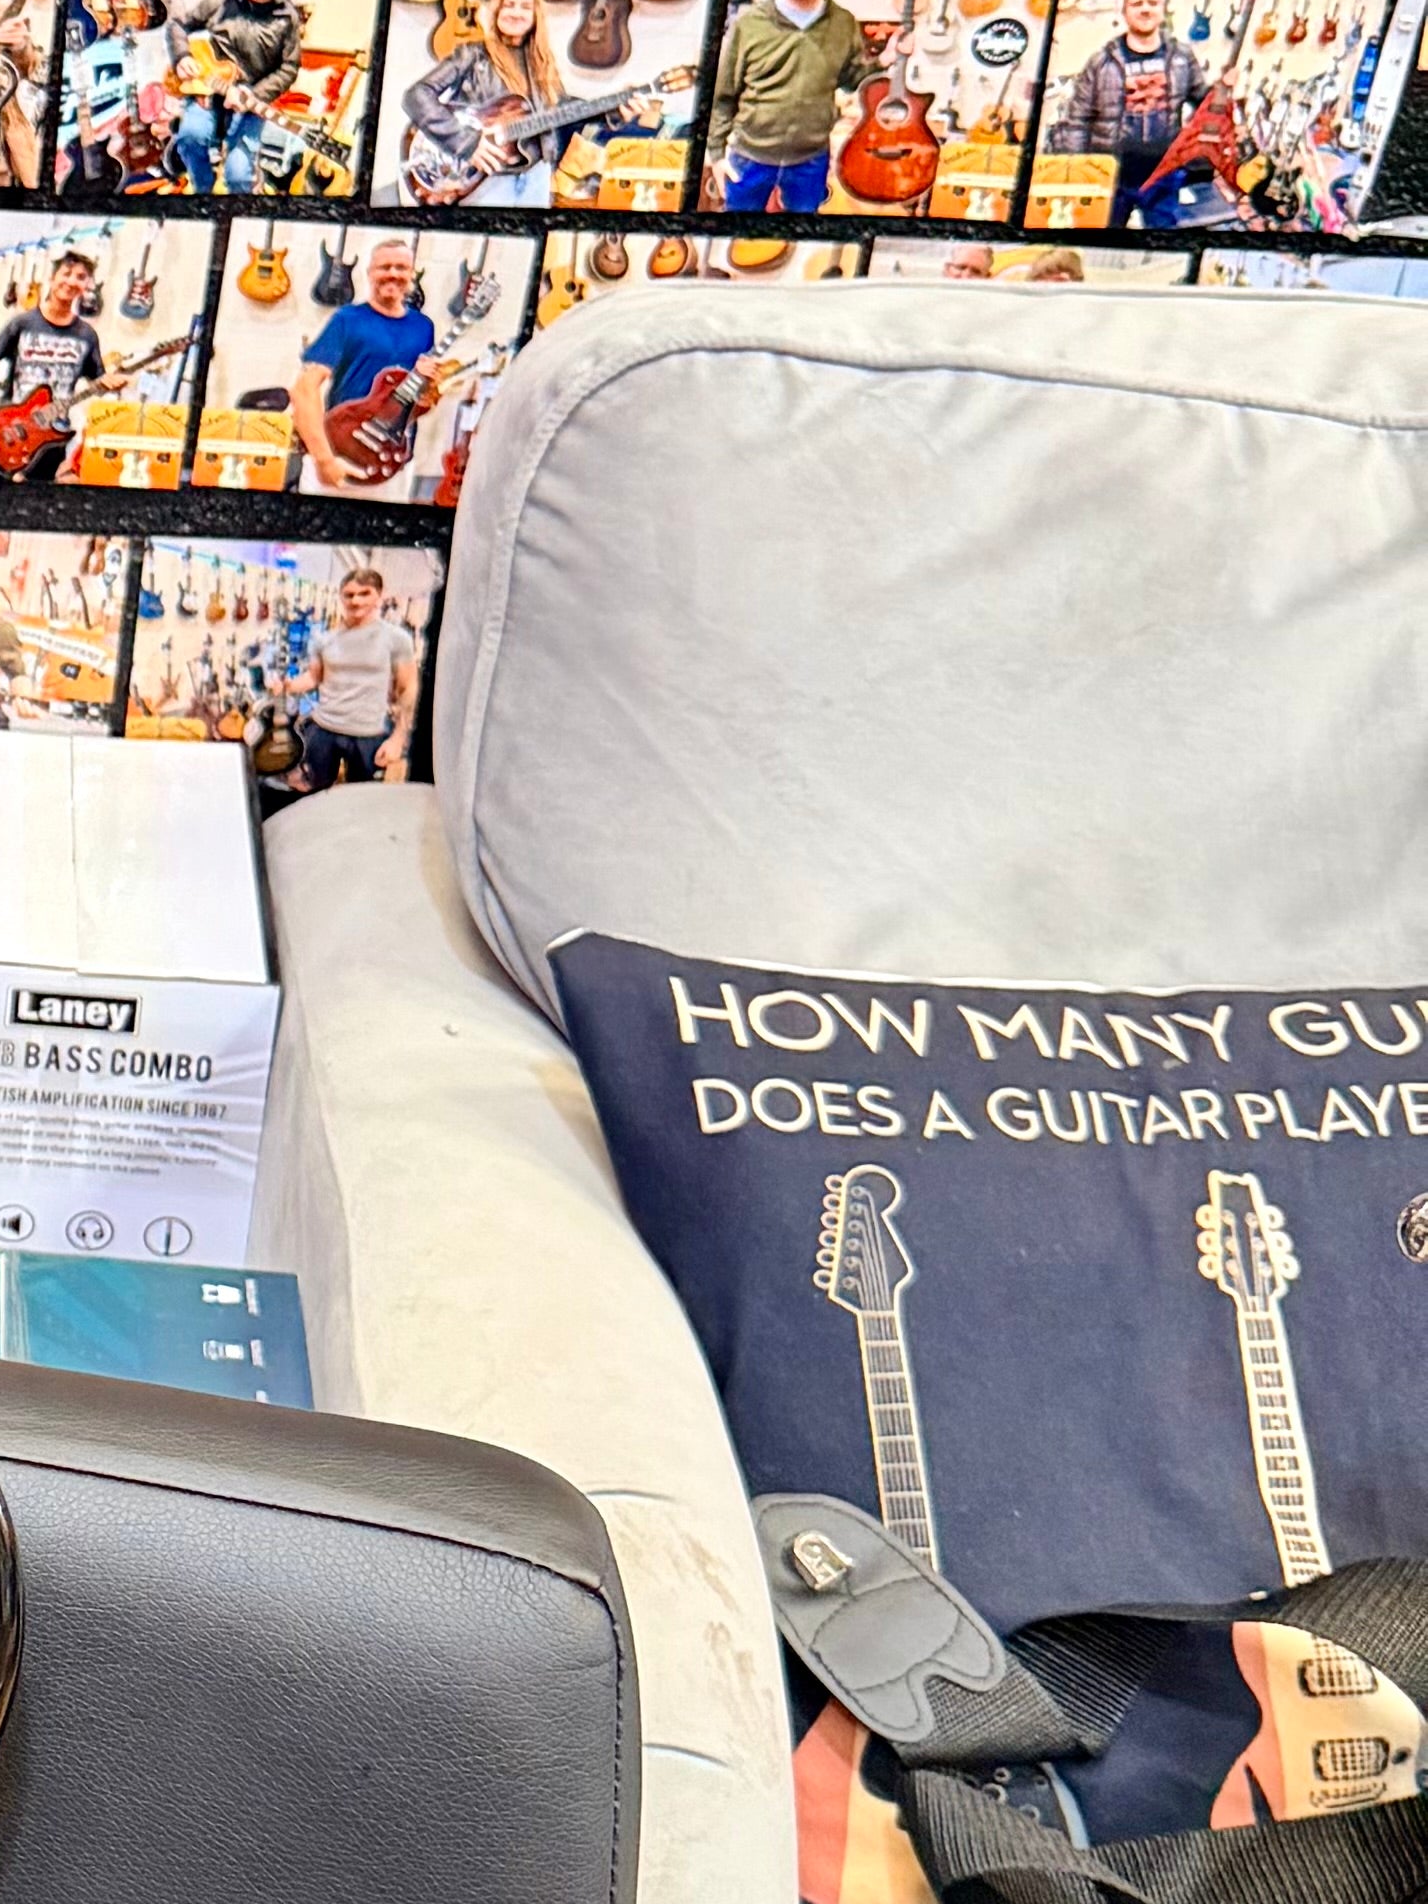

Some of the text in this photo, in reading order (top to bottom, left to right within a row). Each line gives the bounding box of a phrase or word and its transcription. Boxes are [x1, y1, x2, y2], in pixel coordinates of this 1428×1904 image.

[17, 989, 131, 1032] Laney
[668, 976, 930, 1061] HOW
[956, 1001, 1233, 1072] MANY
[23, 1041, 102, 1075] BASS
[109, 1047, 214, 1083] COMBO
[29, 1091, 144, 1112] AMPLIFICATION
[146, 1098, 190, 1116] SINCE
[691, 1077, 1428, 1146] DOES A GUITAR PLAYE
